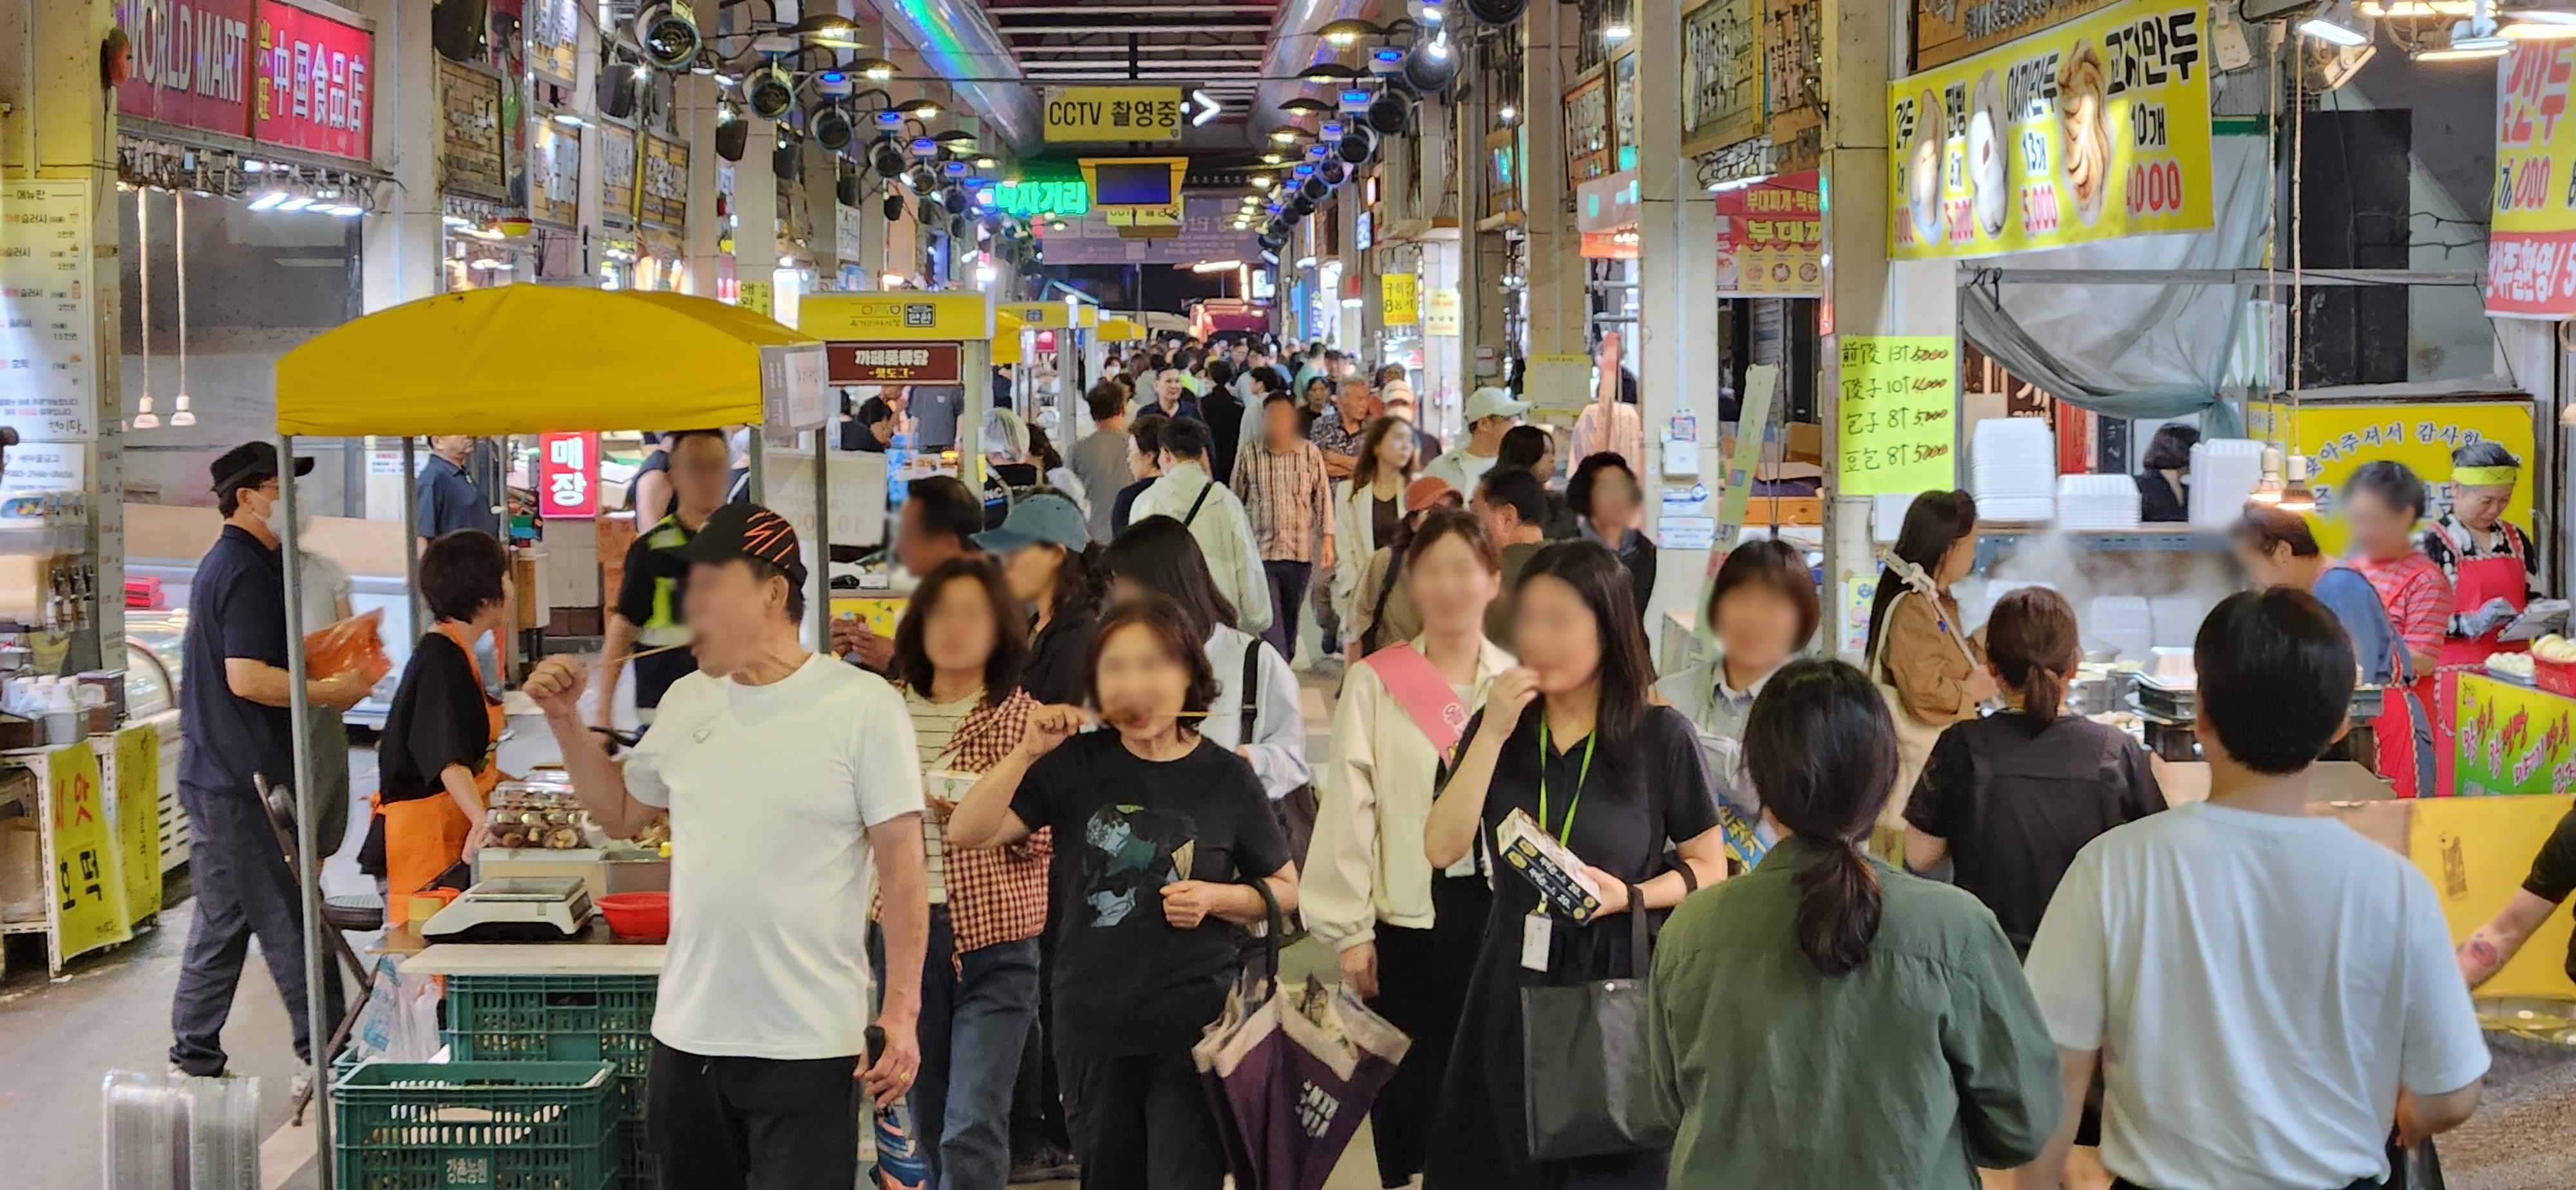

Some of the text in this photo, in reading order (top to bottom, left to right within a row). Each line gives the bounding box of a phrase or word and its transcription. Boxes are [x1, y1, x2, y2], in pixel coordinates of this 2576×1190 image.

[196, 9, 247, 104] MART
[273, 30, 365, 132] 中国食品店
[2106, 12, 2198, 95] 교자만두
[1049, 100, 1177, 128] CCTV 촬영중
[2131, 102, 2166, 146] 10개
[2022, 132, 2047, 171] 13개
[17, 190, 46, 200] 메뉴판
[550, 436, 587, 507] 매장
